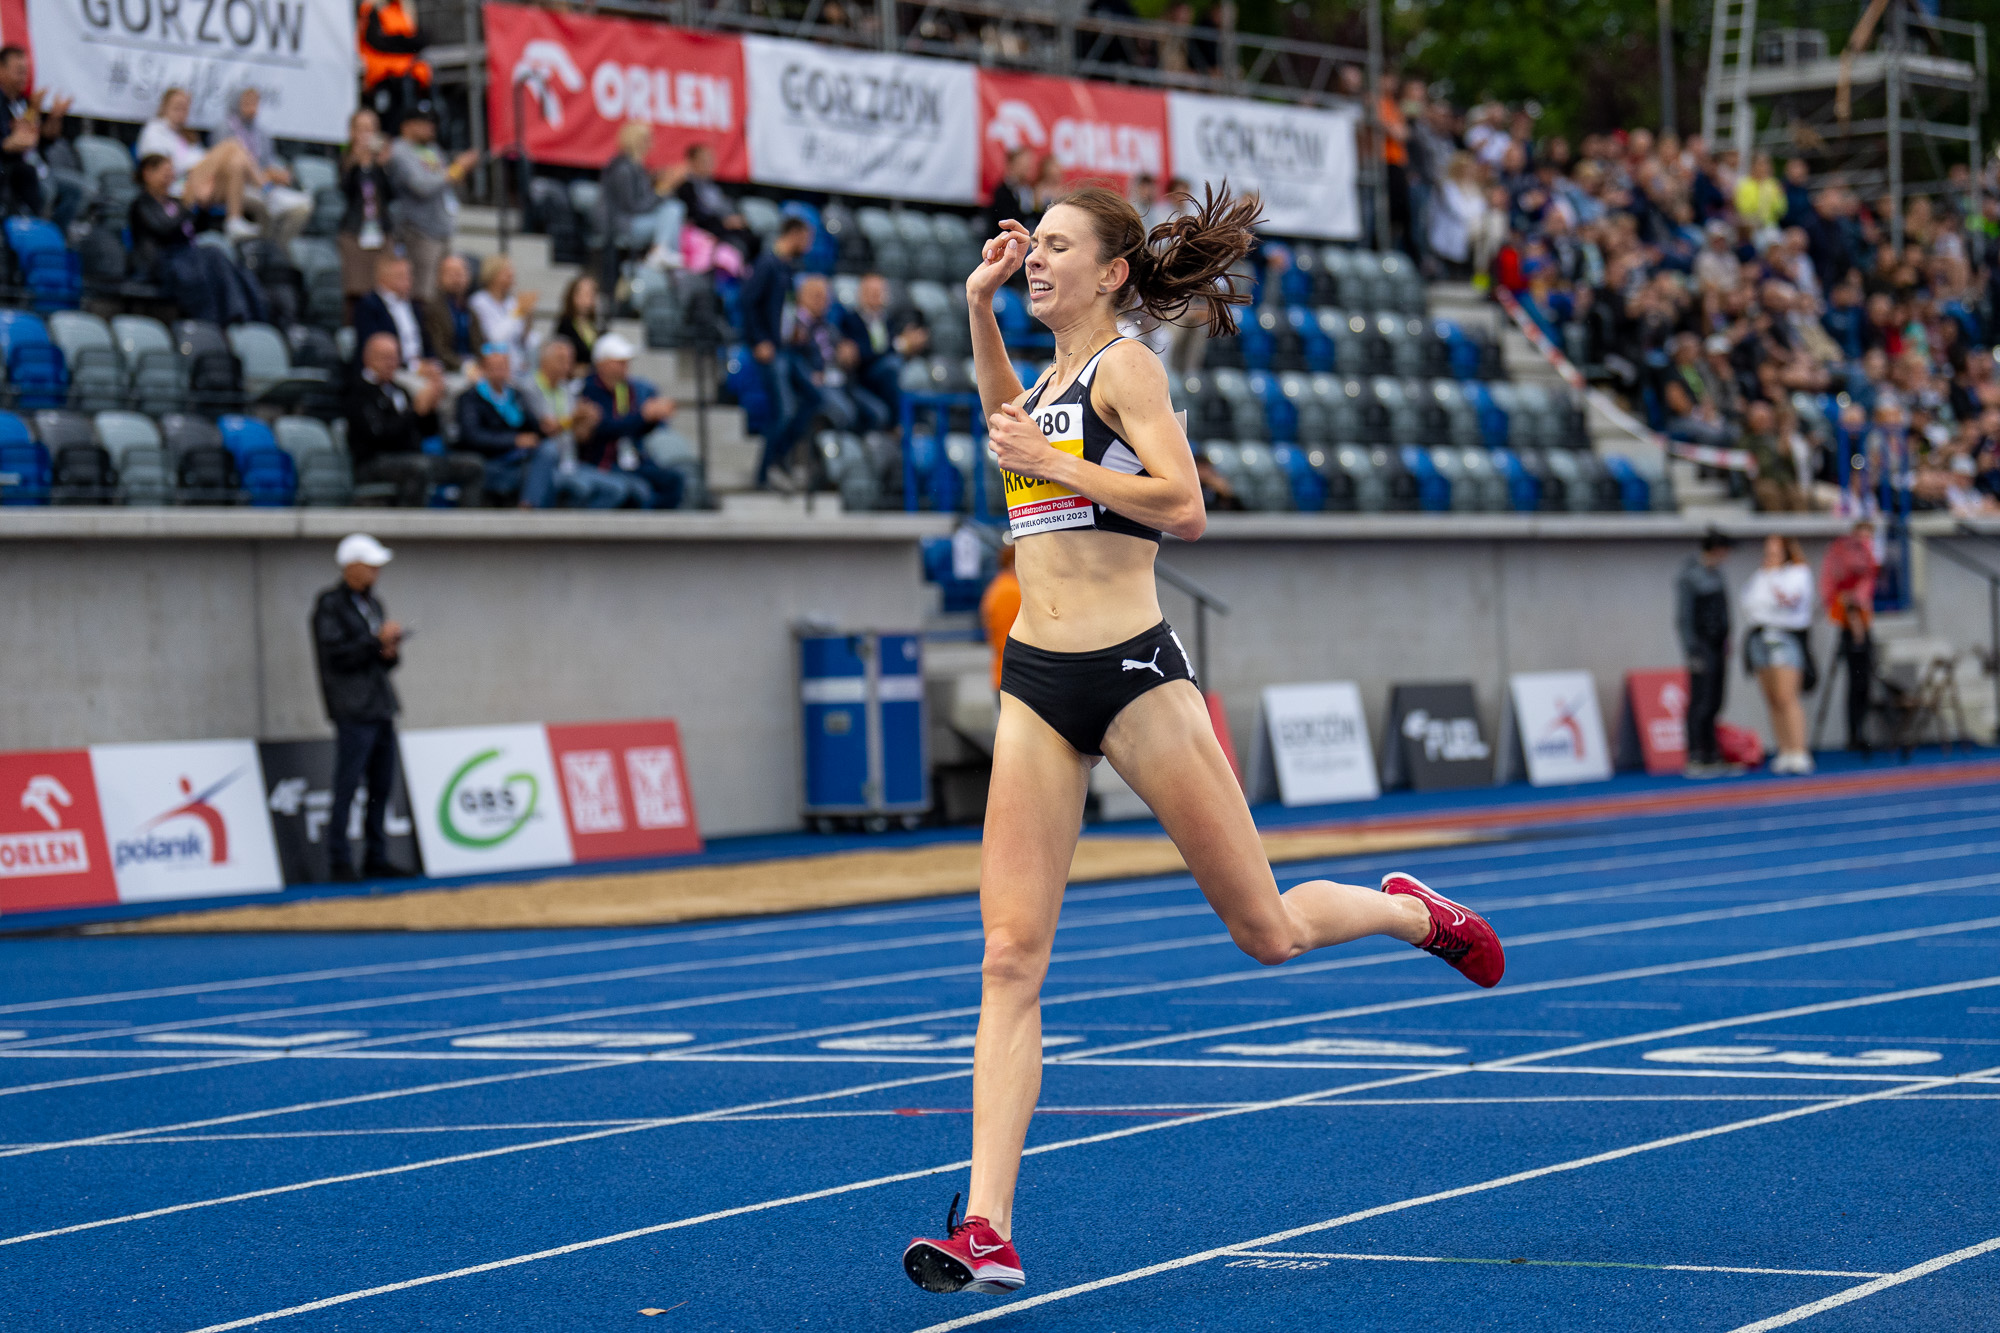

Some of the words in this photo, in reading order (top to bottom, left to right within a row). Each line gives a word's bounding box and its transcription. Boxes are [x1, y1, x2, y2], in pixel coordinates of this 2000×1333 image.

[592, 61, 734, 132] ORLEN
[1051, 117, 1162, 174] ORLEN
[1020, 514, 1065, 529] WIELKOPOLSKI
[1066, 511, 1088, 521] 2023
[1021, 504, 1052, 516] Mistrzostwa
[1052, 499, 1076, 510] Polski
[459, 788, 516, 813] GBS
[0, 841, 80, 868] ORLEN
[115, 829, 201, 869] polanik
